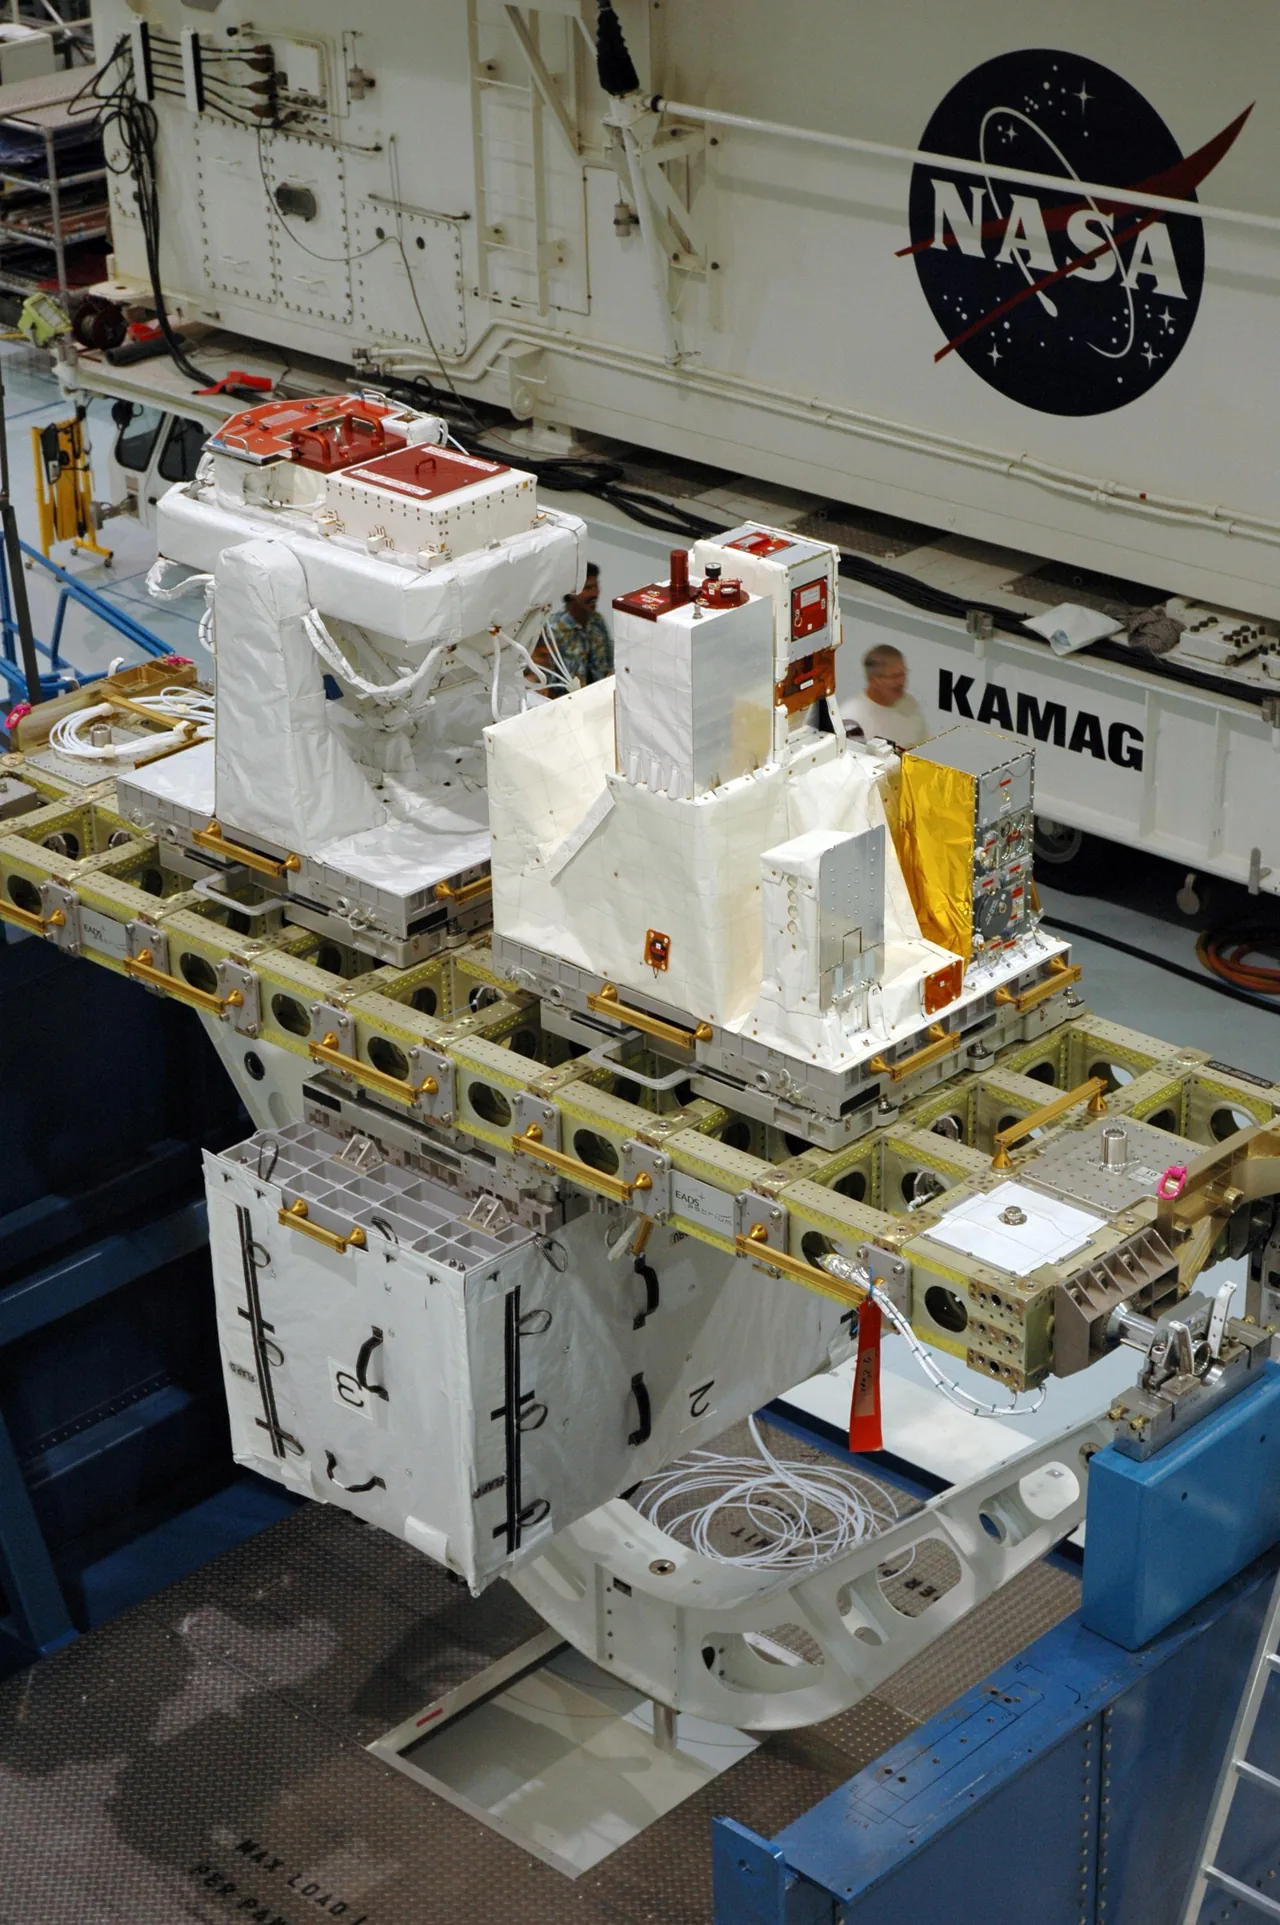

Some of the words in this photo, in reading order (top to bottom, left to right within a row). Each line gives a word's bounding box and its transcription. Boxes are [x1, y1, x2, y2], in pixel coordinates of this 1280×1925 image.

[930, 178, 1188, 300] NASA
[938, 668, 1144, 772] KAMAG
[675, 1189, 700, 1208] EADS
[336, 1371, 364, 1408] 3
[689, 1379, 715, 1418] 2
[287, 1873, 348, 1916] LOAD
